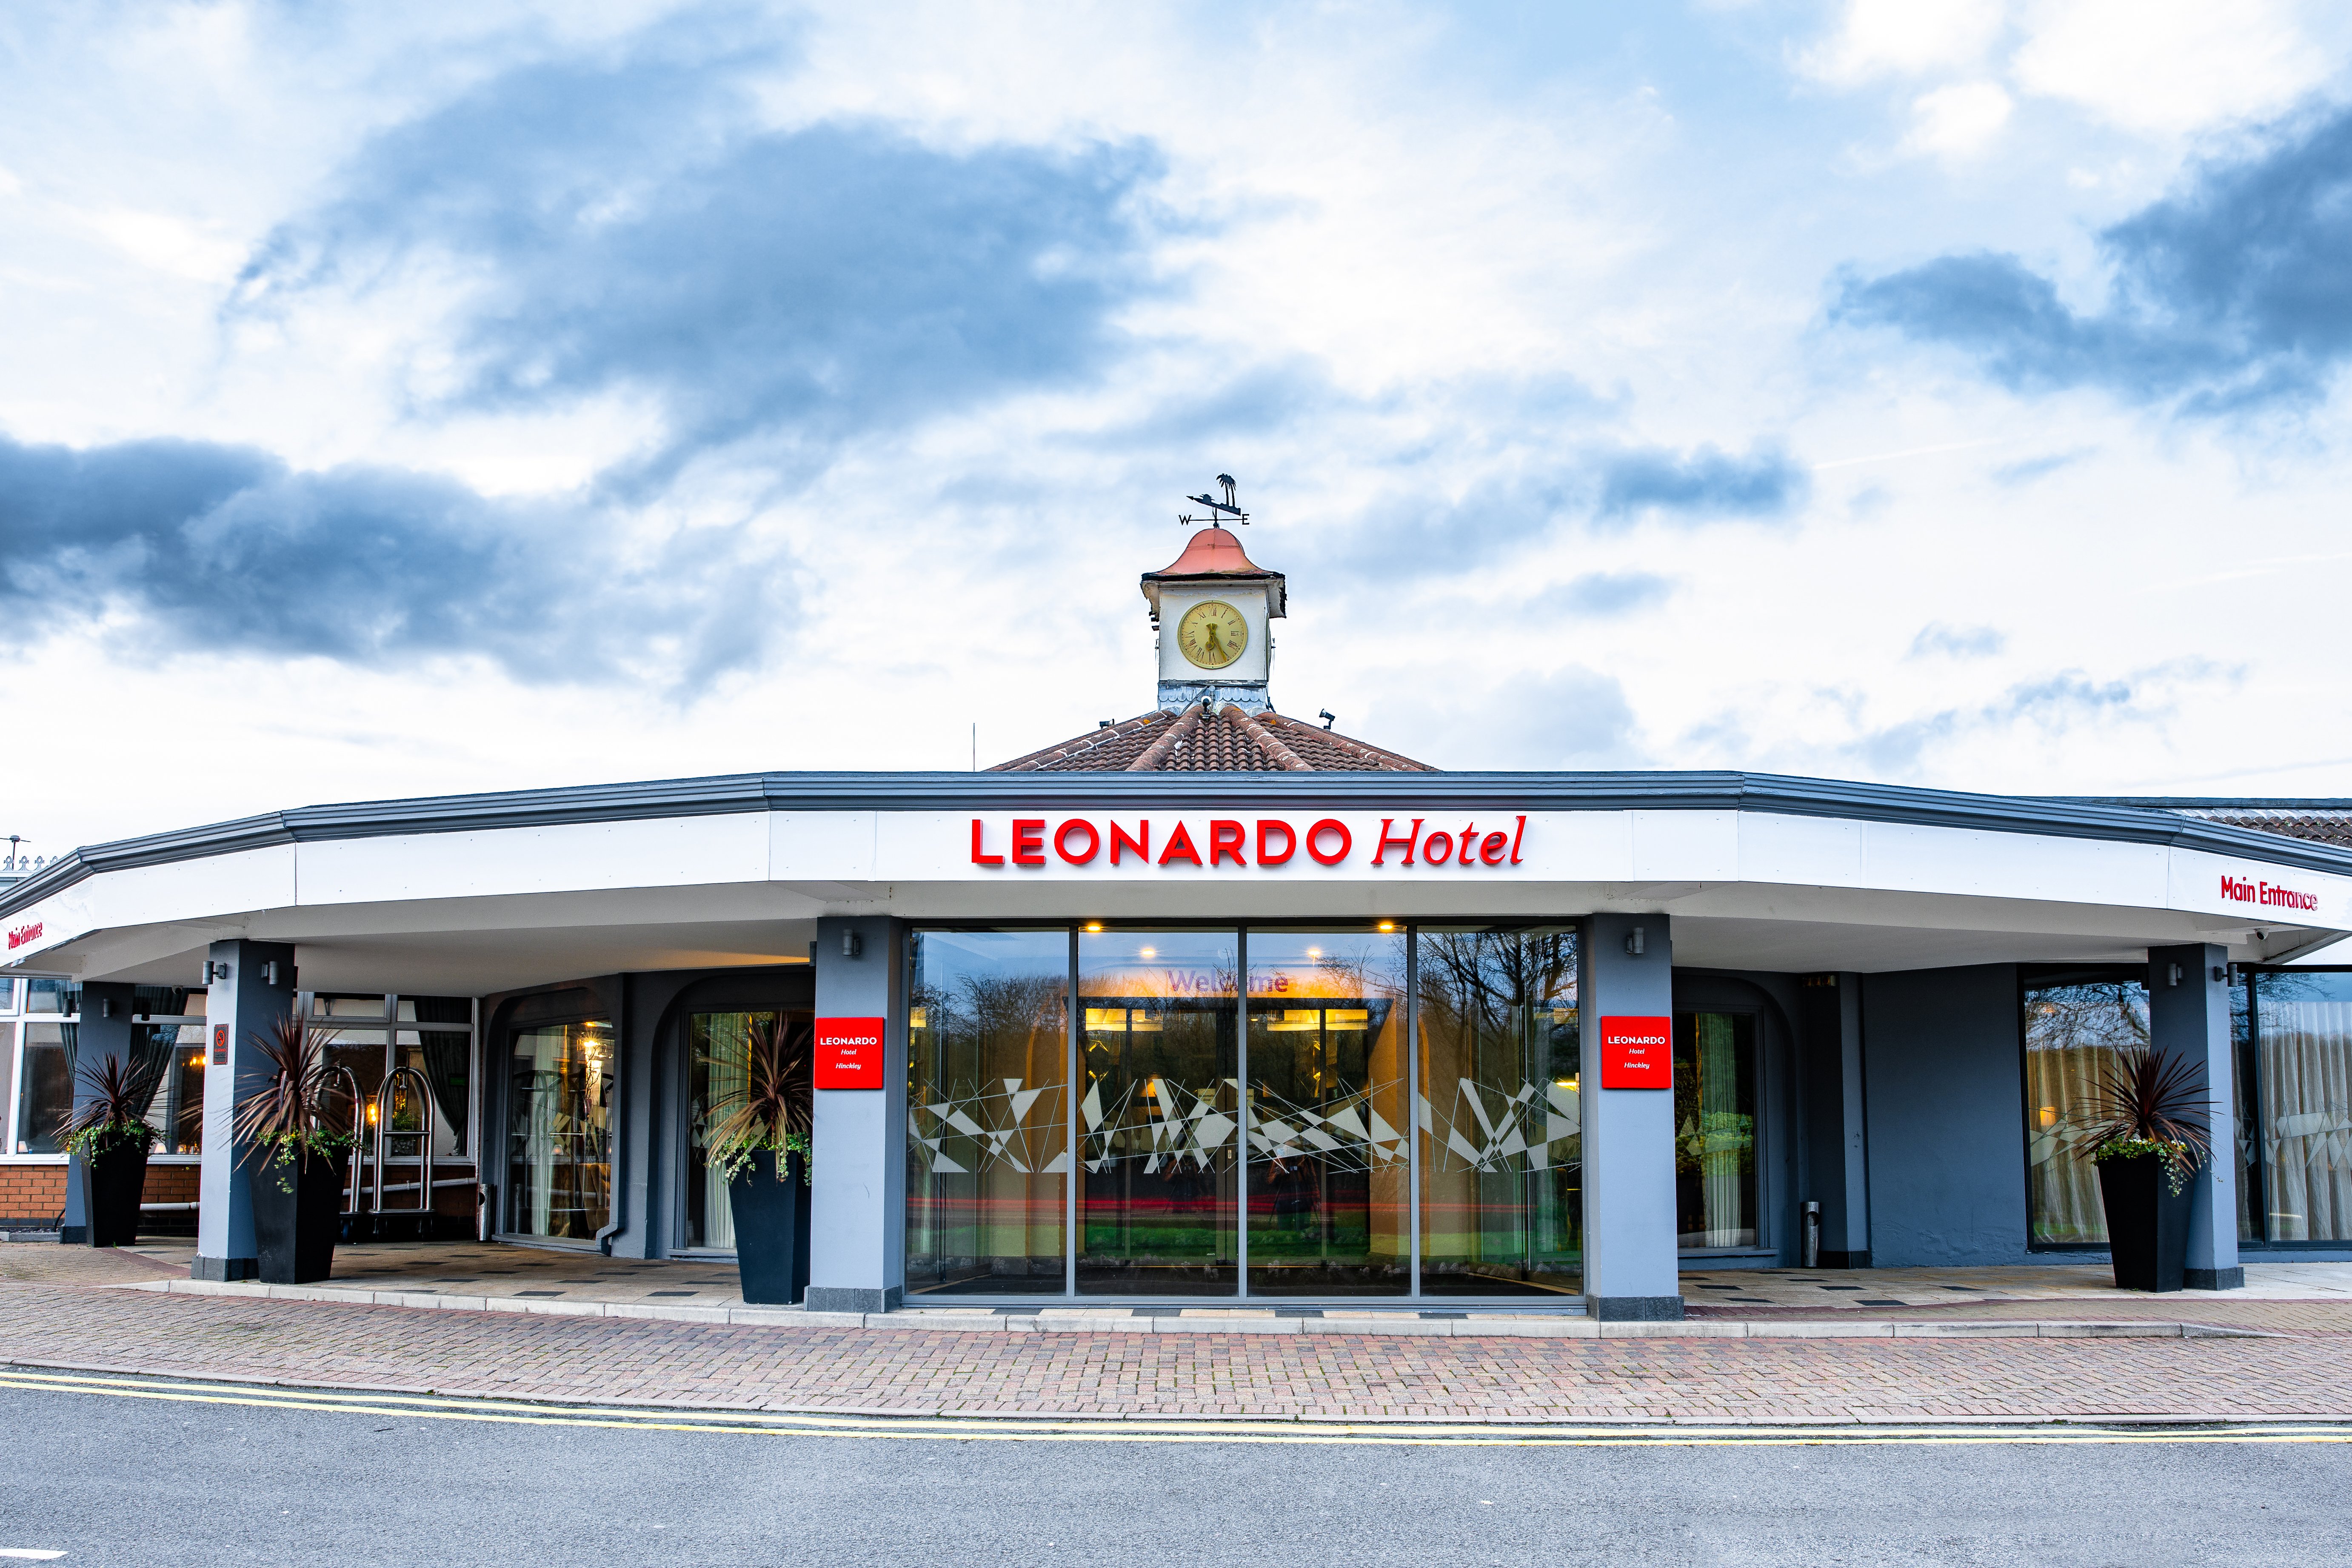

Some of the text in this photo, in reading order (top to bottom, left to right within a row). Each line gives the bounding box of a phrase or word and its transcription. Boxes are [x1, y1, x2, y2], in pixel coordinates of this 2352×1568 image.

[1179, 514, 1192, 526] W
[1242, 514, 1250, 525] E
[971, 815, 1527, 865] LEONARDO Hotel
[2221, 875, 2318, 911] Main Entrance
[9, 922, 43, 950] Main Entrance
[820, 1037, 877, 1045] LEONARDO
[1608, 1036, 1665, 1044] LEONARDO
